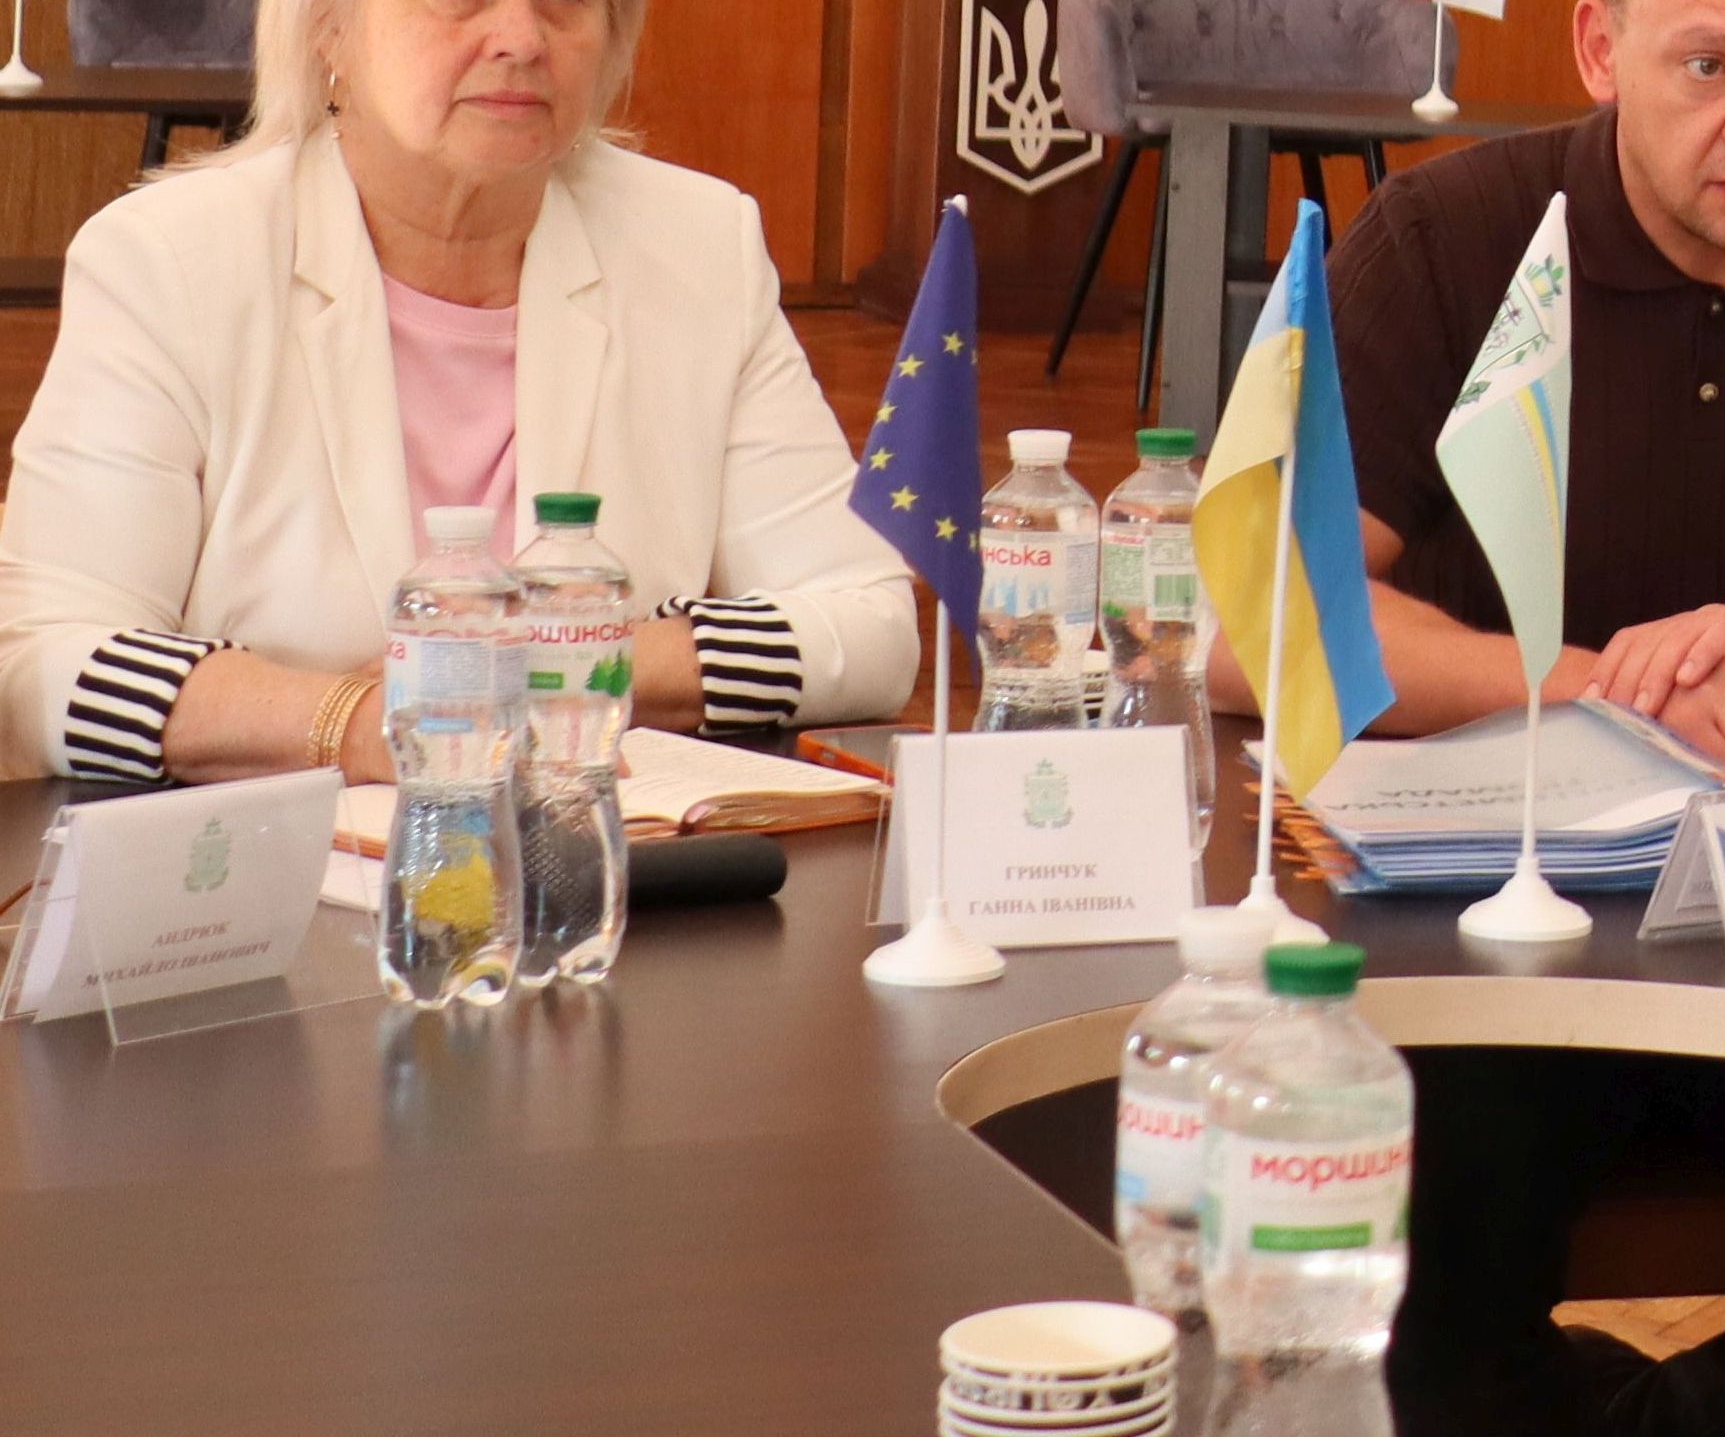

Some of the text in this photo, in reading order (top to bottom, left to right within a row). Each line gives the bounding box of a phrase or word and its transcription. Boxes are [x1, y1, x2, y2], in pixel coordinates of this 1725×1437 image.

[1004, 863, 1098, 881] ГРИНЧУК
[968, 895, 1136, 916] ГАННА ІВАНІВНА
